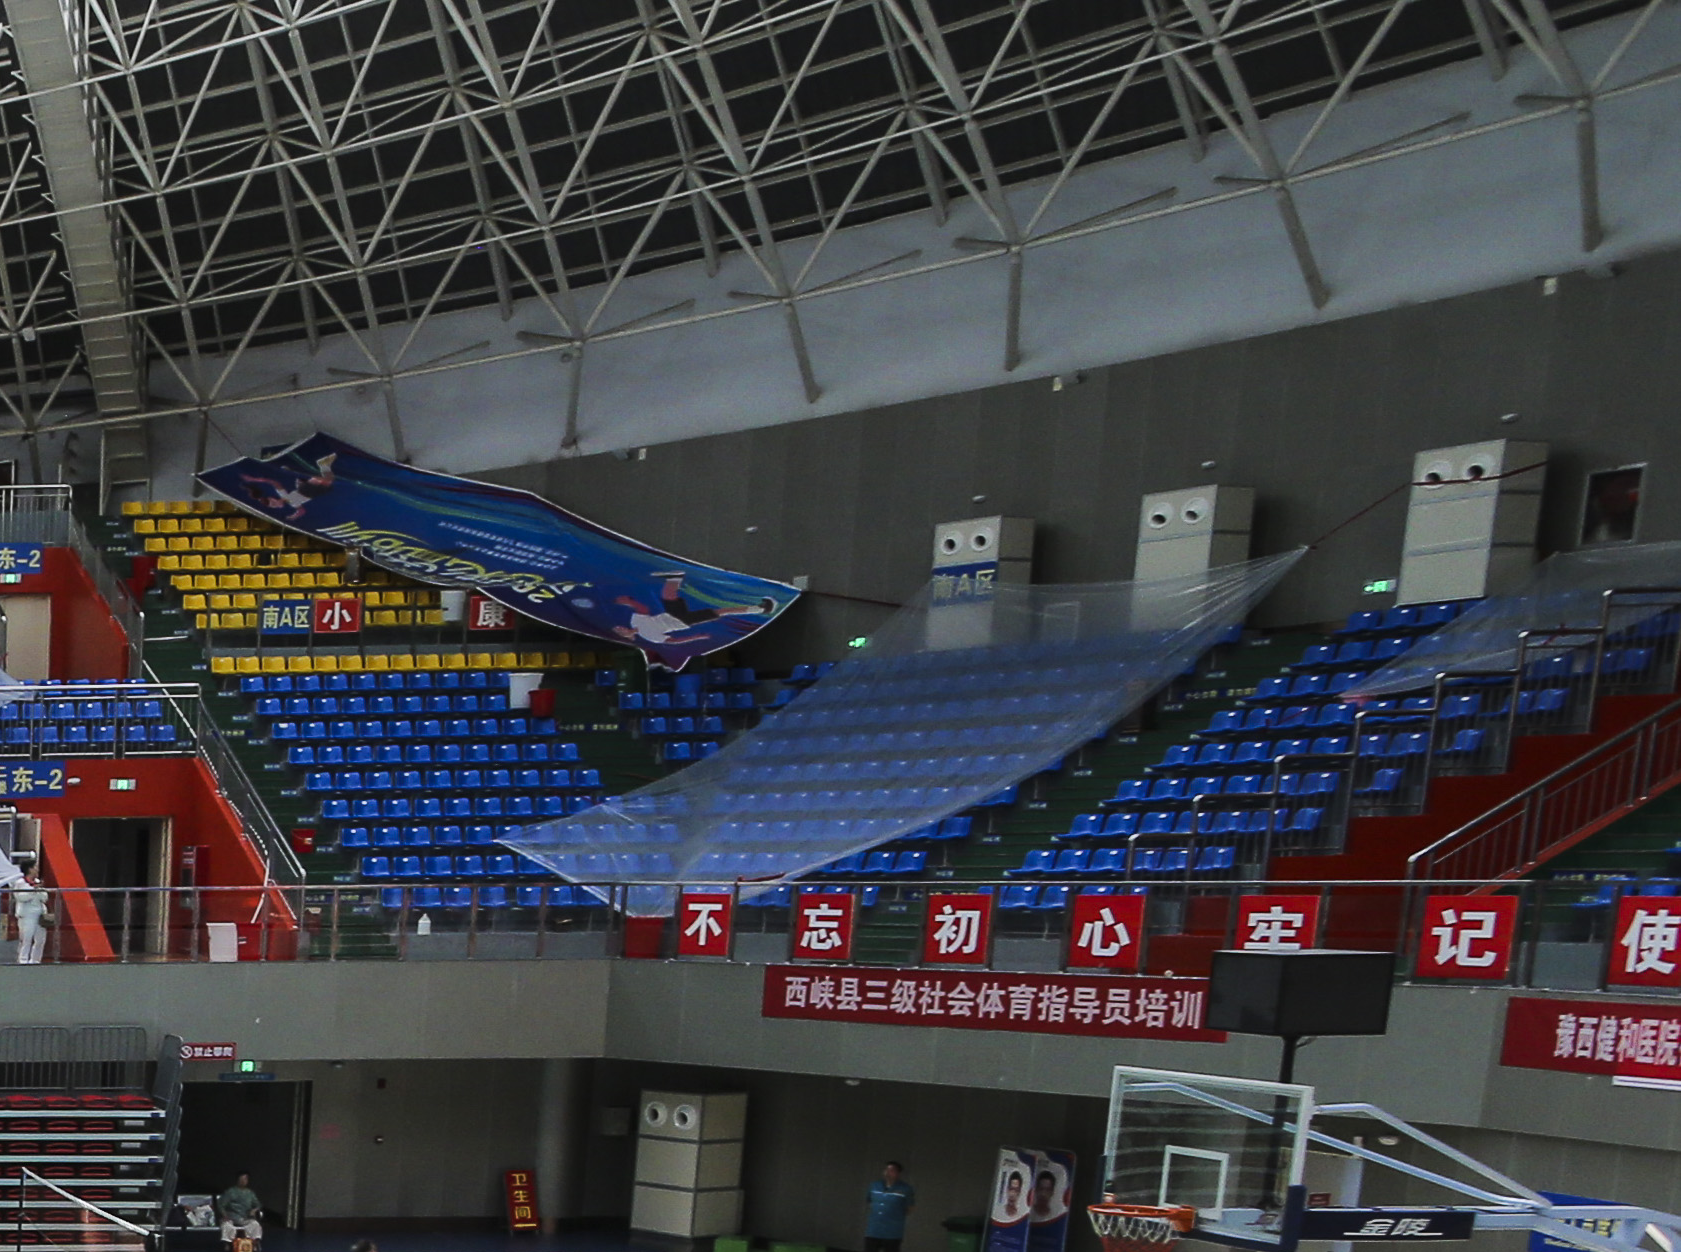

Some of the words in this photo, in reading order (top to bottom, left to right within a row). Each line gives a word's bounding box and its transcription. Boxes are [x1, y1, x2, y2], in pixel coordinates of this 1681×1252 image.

[263, 605, 310, 628] 南A区
[322, 601, 352, 630] 小
[478, 600, 505, 627] 康
[12, 766, 63, 793] 东-2
[685, 904, 723, 946] 不
[800, 904, 843, 949] 忘
[934, 905, 980, 953] 初
[1078, 908, 1130, 956] 心
[1243, 905, 1305, 950] 牢
[1432, 909, 1496, 966] 记
[1621, 909, 1681, 974] 使
[785, 974, 1204, 1029] 西峡县三级社会体育指导员培训
[1554, 1013, 1681, 1066] 豫西健和医院
[511, 1173, 532, 1219] 卫生间
